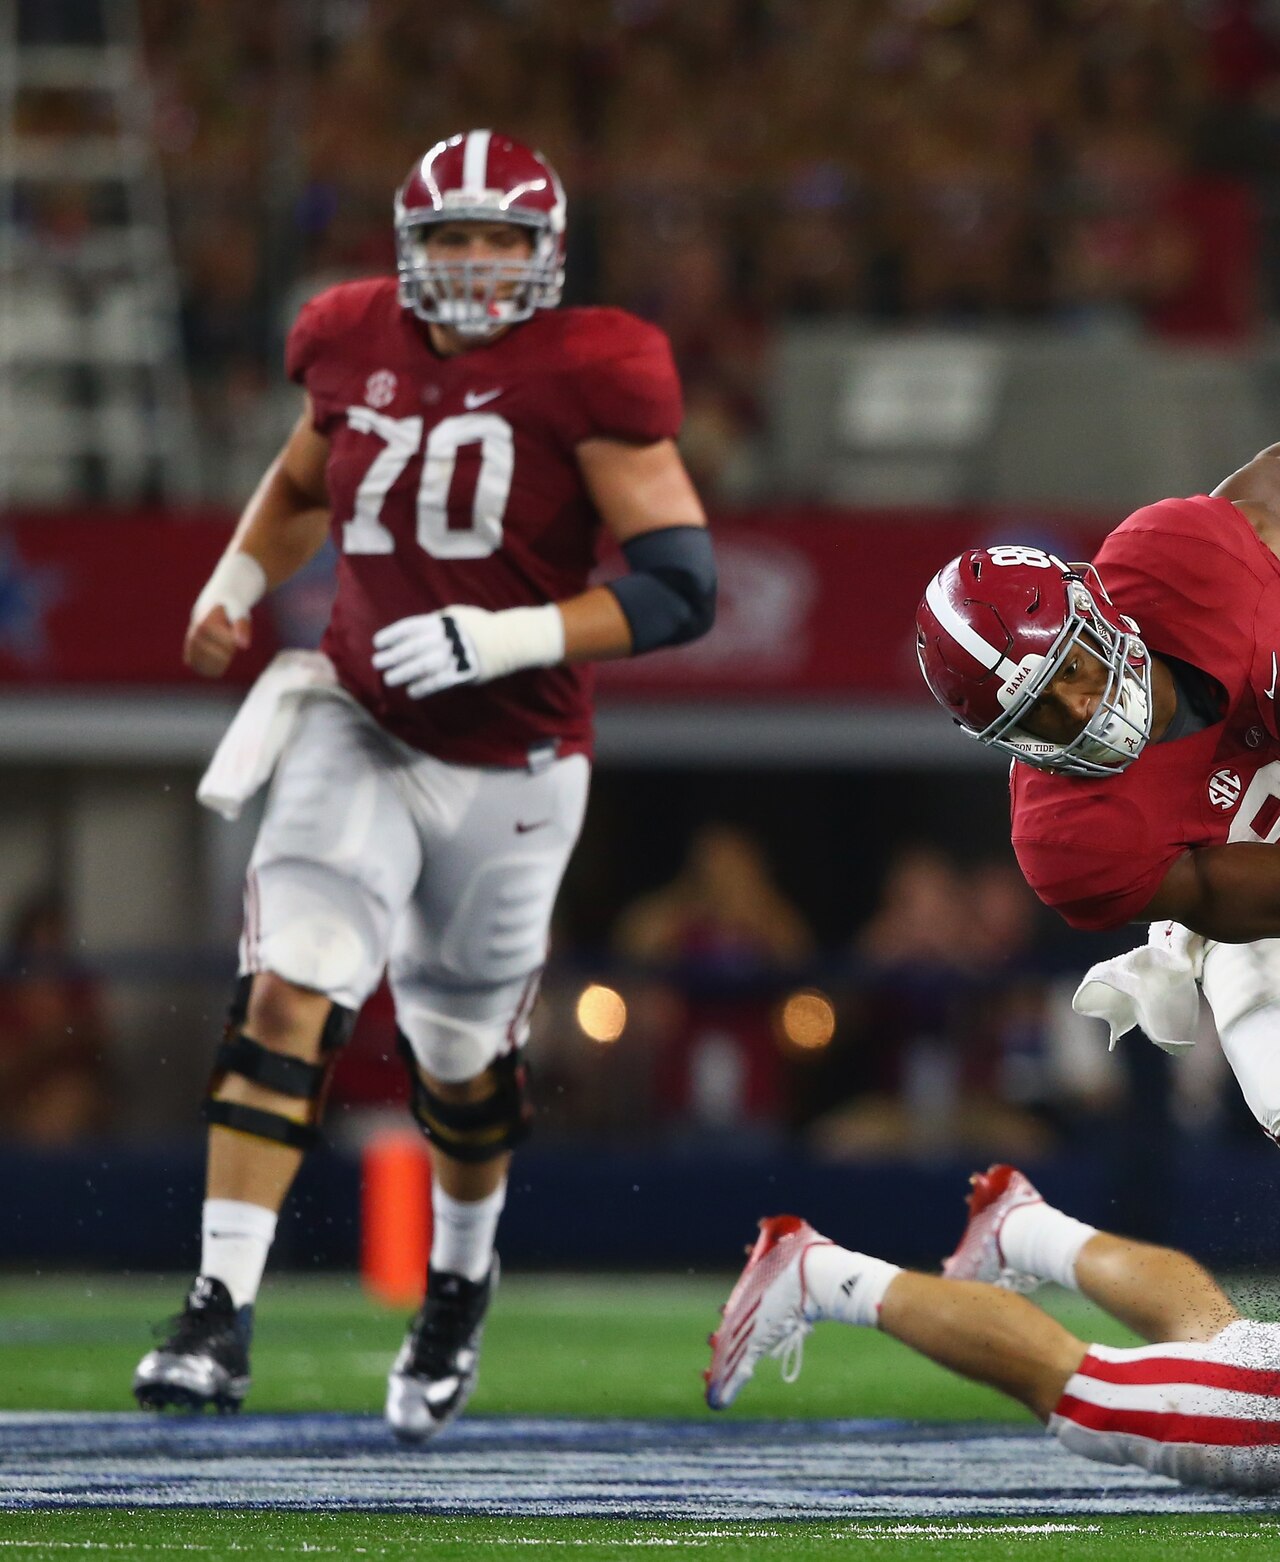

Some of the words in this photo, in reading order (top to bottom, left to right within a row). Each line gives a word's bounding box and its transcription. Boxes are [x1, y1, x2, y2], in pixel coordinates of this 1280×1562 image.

[343, 405, 515, 560] 70
[986, 545, 1052, 569] 88
[1005, 667, 1032, 696] BAMA
[1034, 744, 1055, 753] TIDE
[1208, 769, 1241, 811] SEC
